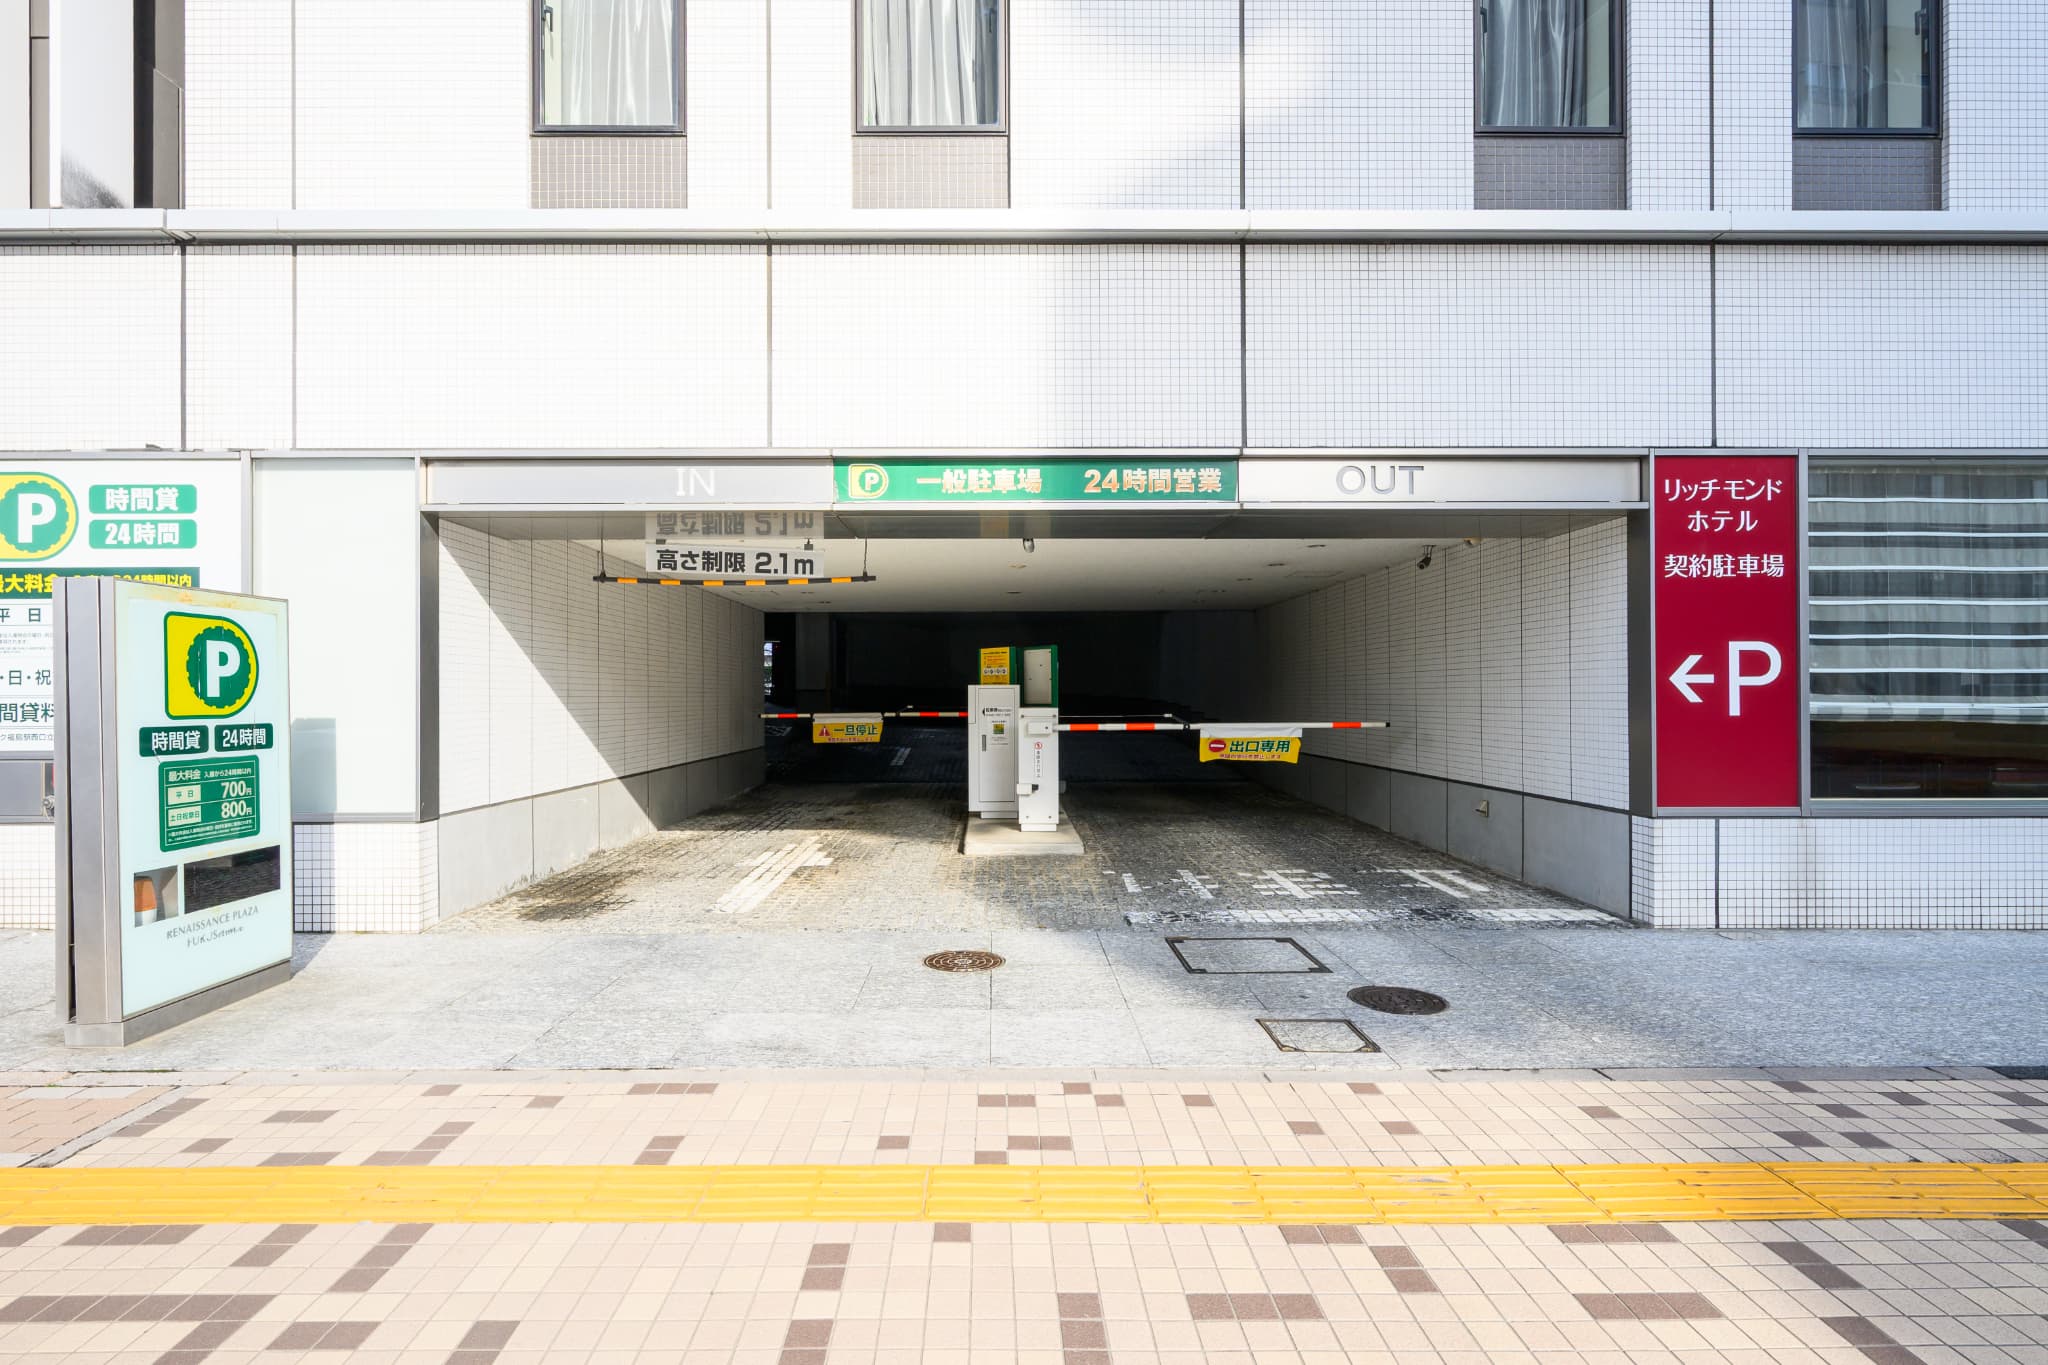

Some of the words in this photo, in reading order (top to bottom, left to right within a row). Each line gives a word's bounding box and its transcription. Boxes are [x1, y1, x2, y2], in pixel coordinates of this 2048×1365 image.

[676, 467, 715, 496] IN
[916, 468, 1042, 494] 一般駐車場
[1084, 468, 1222, 494] 24時間営業
[1335, 465, 1424, 495] OUT
[1663, 478, 1783, 502] リッチモンド
[105, 487, 180, 511] 時間貸
[18, 493, 57, 544] P
[1687, 510, 1758, 532] ホテル
[105, 522, 179, 545] 24時間
[656, 549, 746, 573] 高さ制限
[754, 552, 814, 575] 2.1m
[1663, 553, 1785, 578] 契約駐車場
[206, 639, 241, 697] P
[1728, 640, 1782, 716] P
[151, 730, 201, 751] 時間貸
[222, 728, 266, 747] 24時間
[833, 724, 878, 736] 一旦停止
[1229, 739, 1290, 752] 出口専用
[168, 768, 201, 782] 最大料金
[221, 780, 252, 798] 700円
[221, 800, 252, 818] 800円
[166, 913, 230, 939] RENAISSANCE
[232, 905, 259, 921] PLAZA
